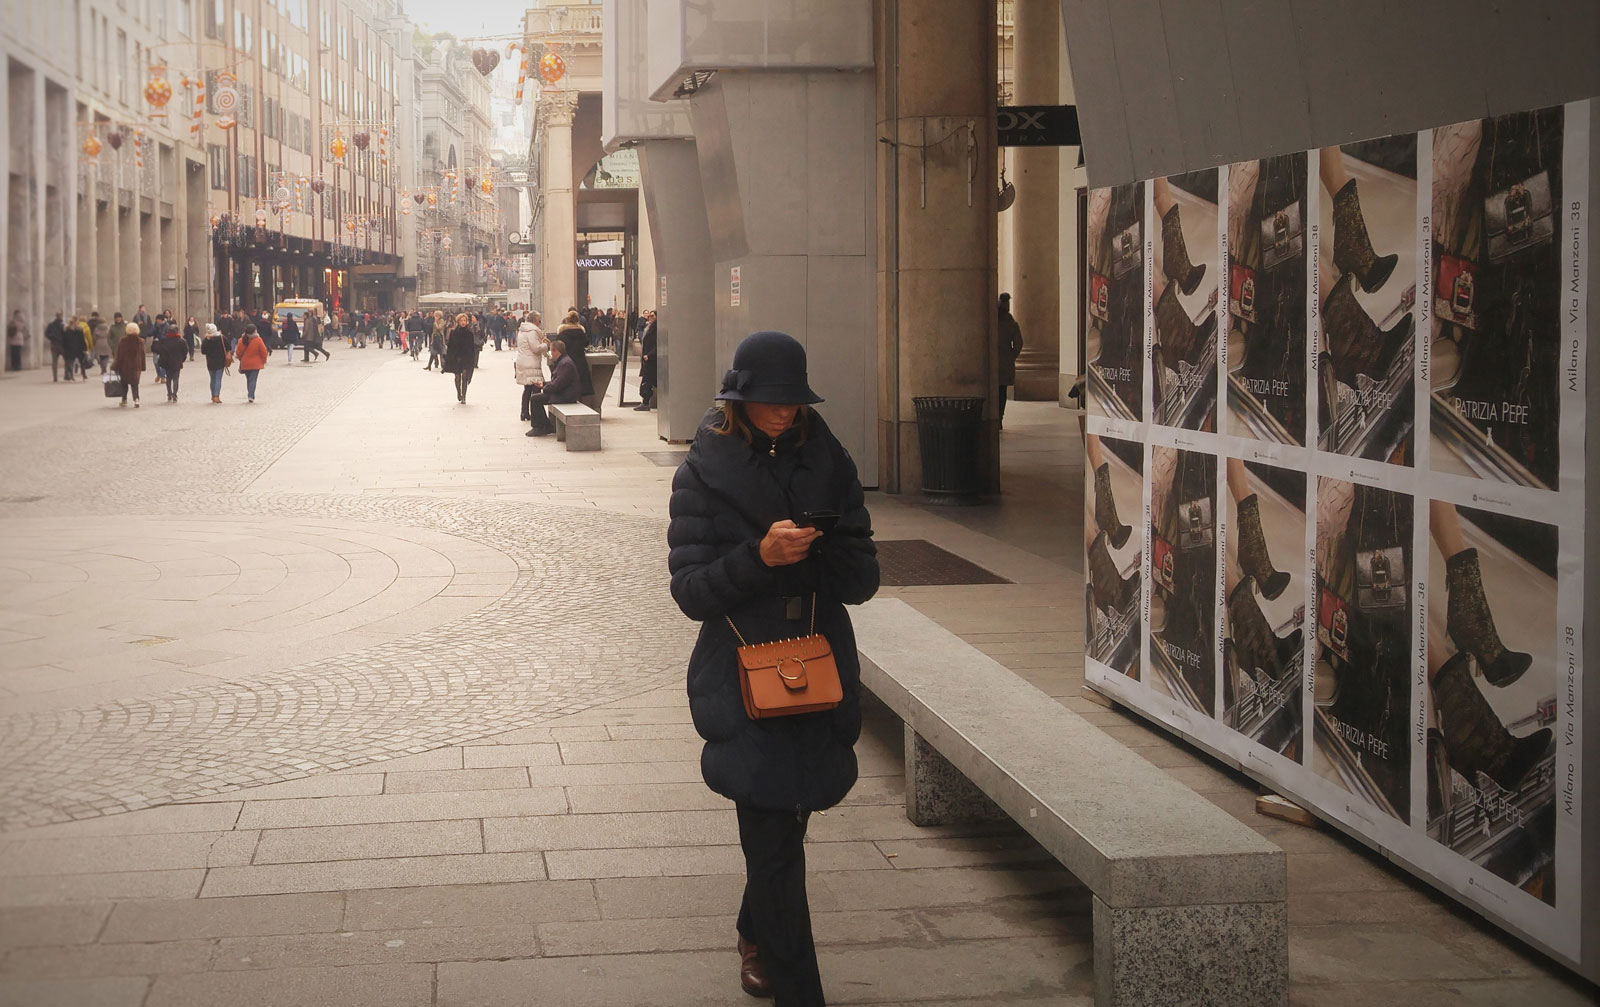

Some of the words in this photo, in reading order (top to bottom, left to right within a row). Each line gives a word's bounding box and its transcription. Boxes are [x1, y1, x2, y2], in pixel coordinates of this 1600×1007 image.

[1571, 200, 1581, 221] 38
[1312, 224, 1319, 240] 38
[1423, 216, 1430, 233] 38
[1422, 238, 1430, 296] Manzoni
[1571, 227, 1580, 293] Manzoni
[1421, 299, 1429, 322] Via
[1569, 298, 1579, 324] Via
[1567, 338, 1579, 392] Milano
[1242, 376, 1270, 395] PATRIZIA
[1271, 379, 1289, 397] PEPE
[1371, 389, 1392, 410] PEPE
[1455, 397, 1498, 422] PATRIZIA
[1501, 401, 1529, 425] PEPE
[1310, 549, 1316, 564] 38
[1418, 582, 1425, 599] 38
[1565, 626, 1575, 647] 38
[1565, 651, 1575, 718] Manzoni
[1416, 700, 1424, 746] Milano
[1565, 722, 1575, 747] Via
[1332, 716, 1366, 749] PATRIZIA
[1367, 733, 1389, 760] PEPE
[1563, 762, 1575, 816] Milano
[1451, 779, 1496, 815] PATRIZIA
[1499, 797, 1526, 829] PEPE
